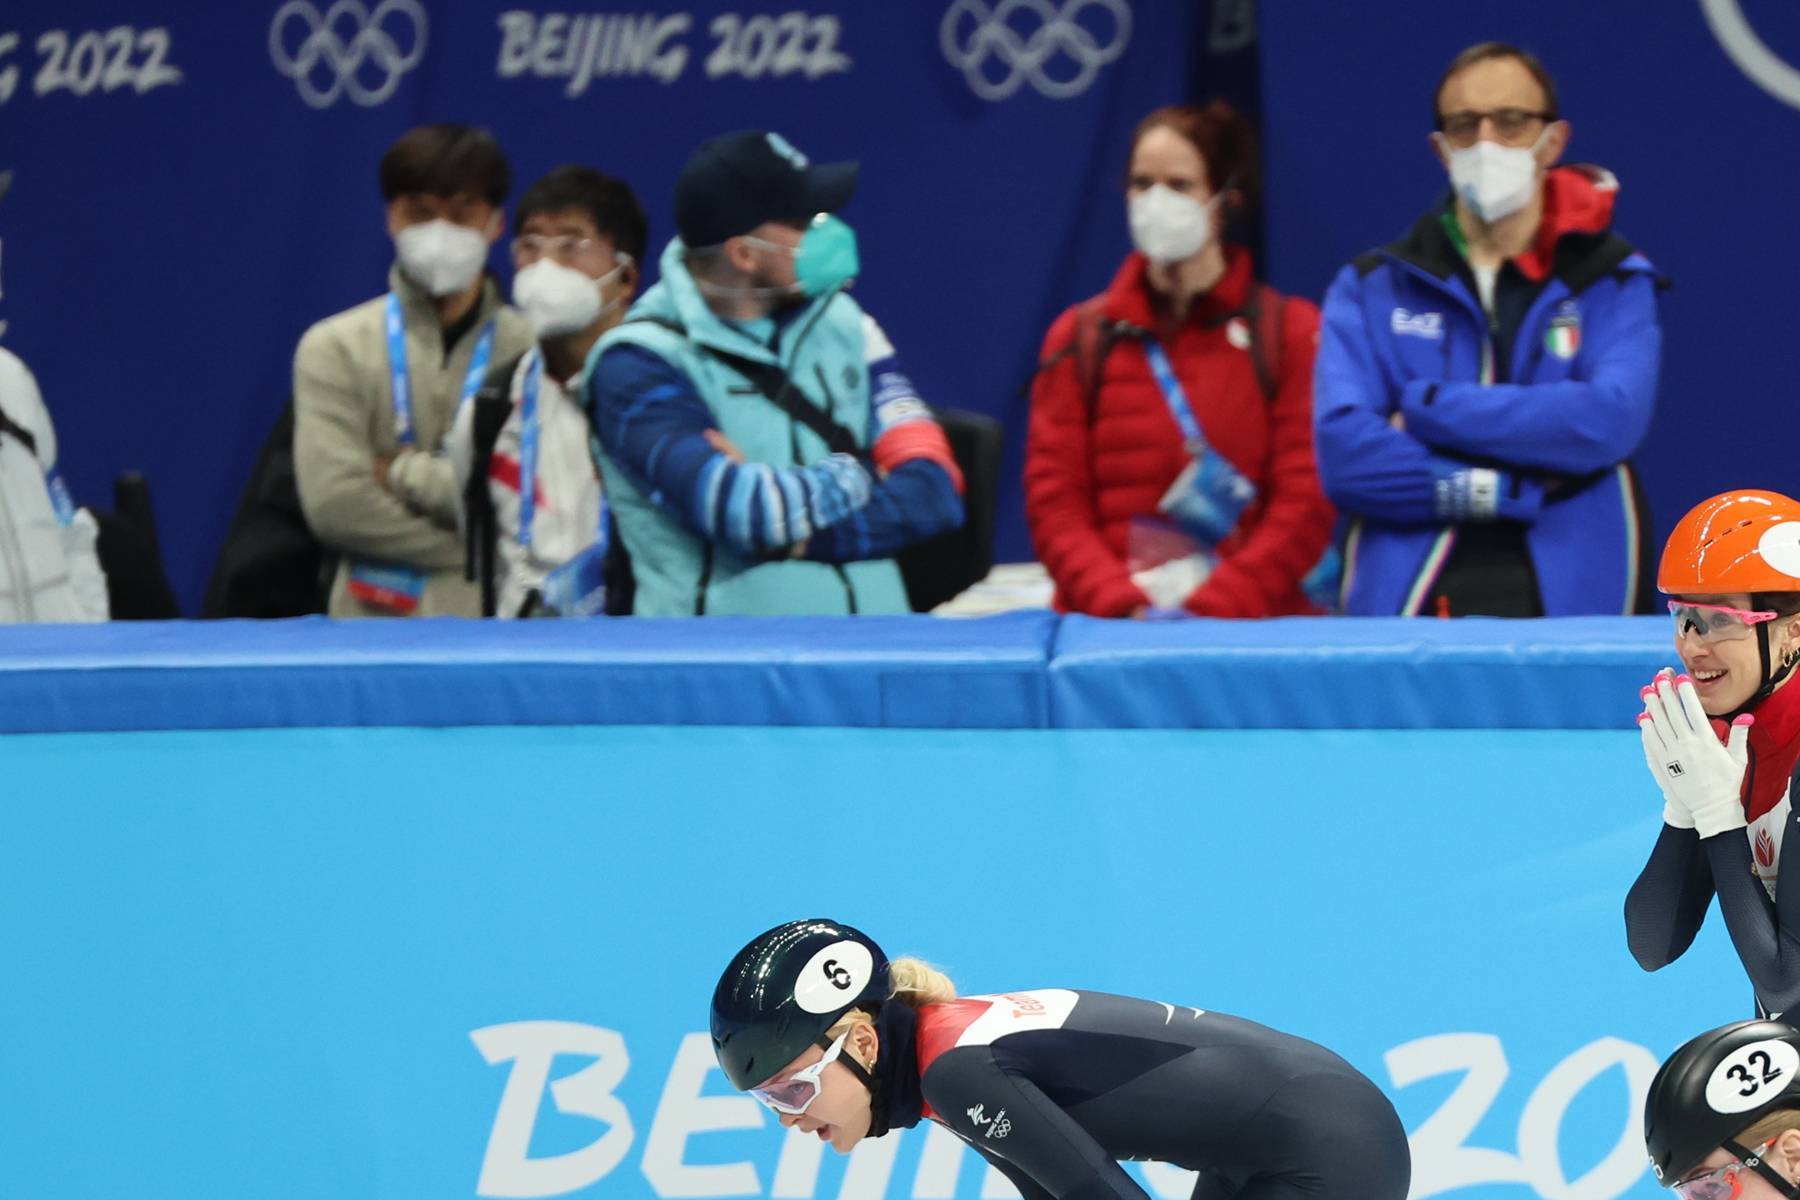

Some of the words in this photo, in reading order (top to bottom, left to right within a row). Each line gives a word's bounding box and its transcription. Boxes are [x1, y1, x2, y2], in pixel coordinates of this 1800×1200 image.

[34, 25, 183, 96] 2022
[496, 10, 693, 99] BEIJING
[703, 11, 855, 80] 2022
[822, 959, 852, 991] 6
[1726, 1051, 1782, 1097] 32
